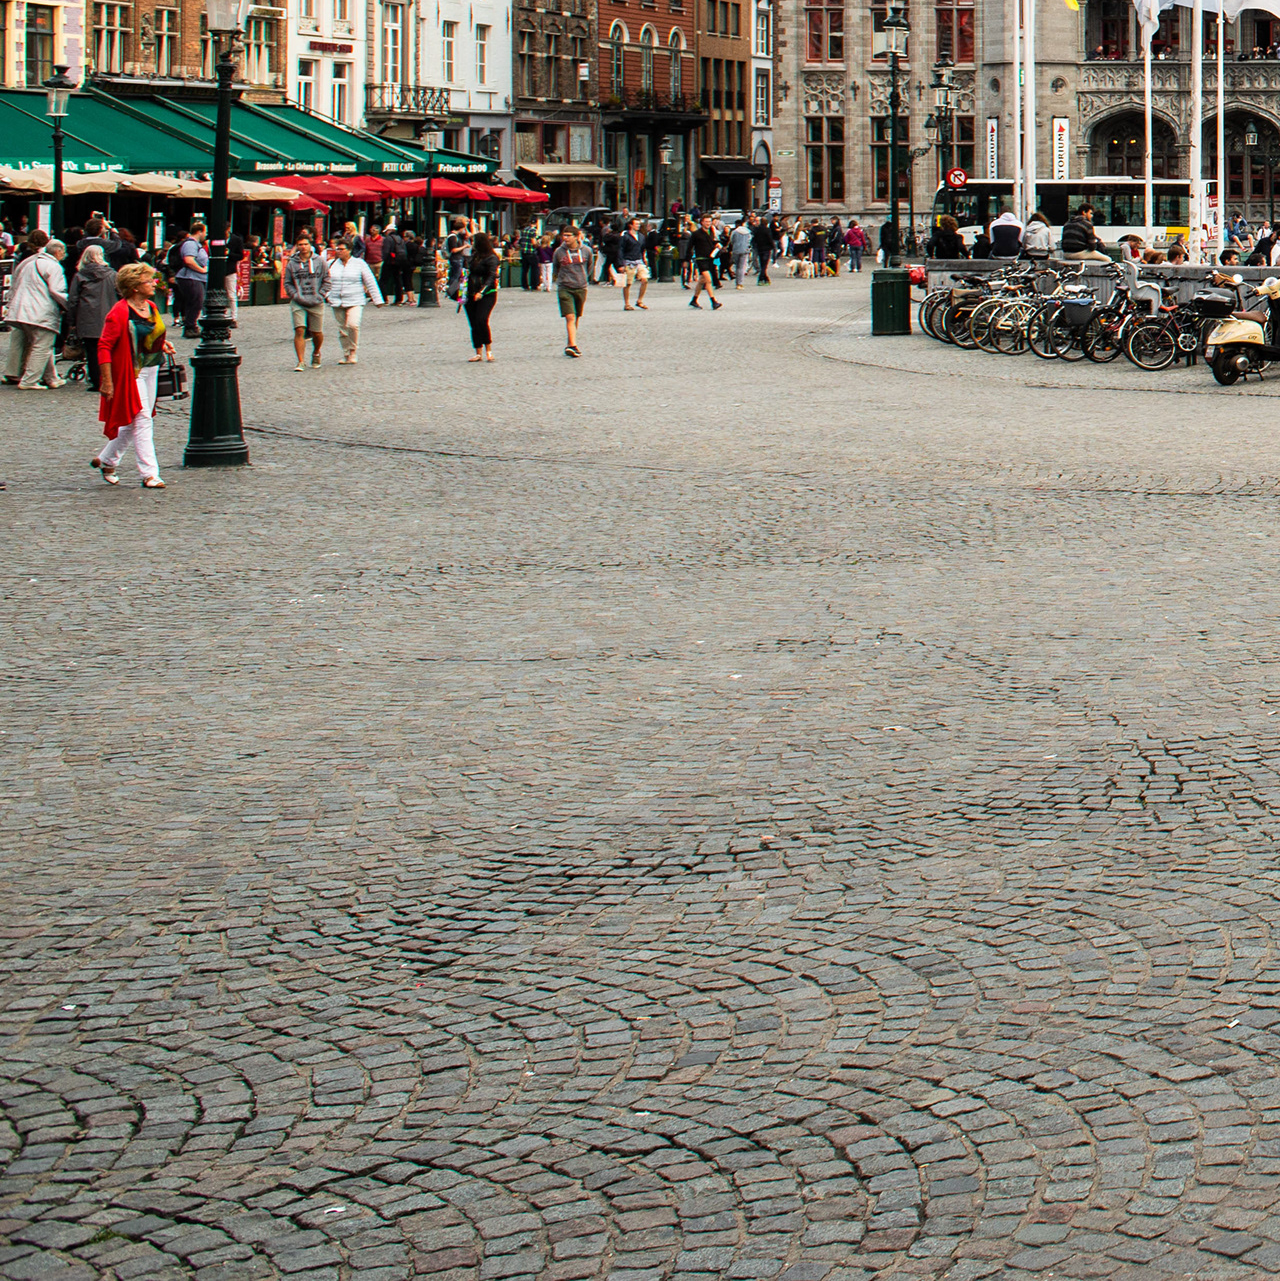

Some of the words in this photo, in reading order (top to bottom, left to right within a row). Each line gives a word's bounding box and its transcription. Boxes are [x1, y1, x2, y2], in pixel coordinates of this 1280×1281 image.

[383, 162, 399, 172] PETIT
[438, 163, 467, 173] Friterie
[468, 164, 488, 173] 1900
